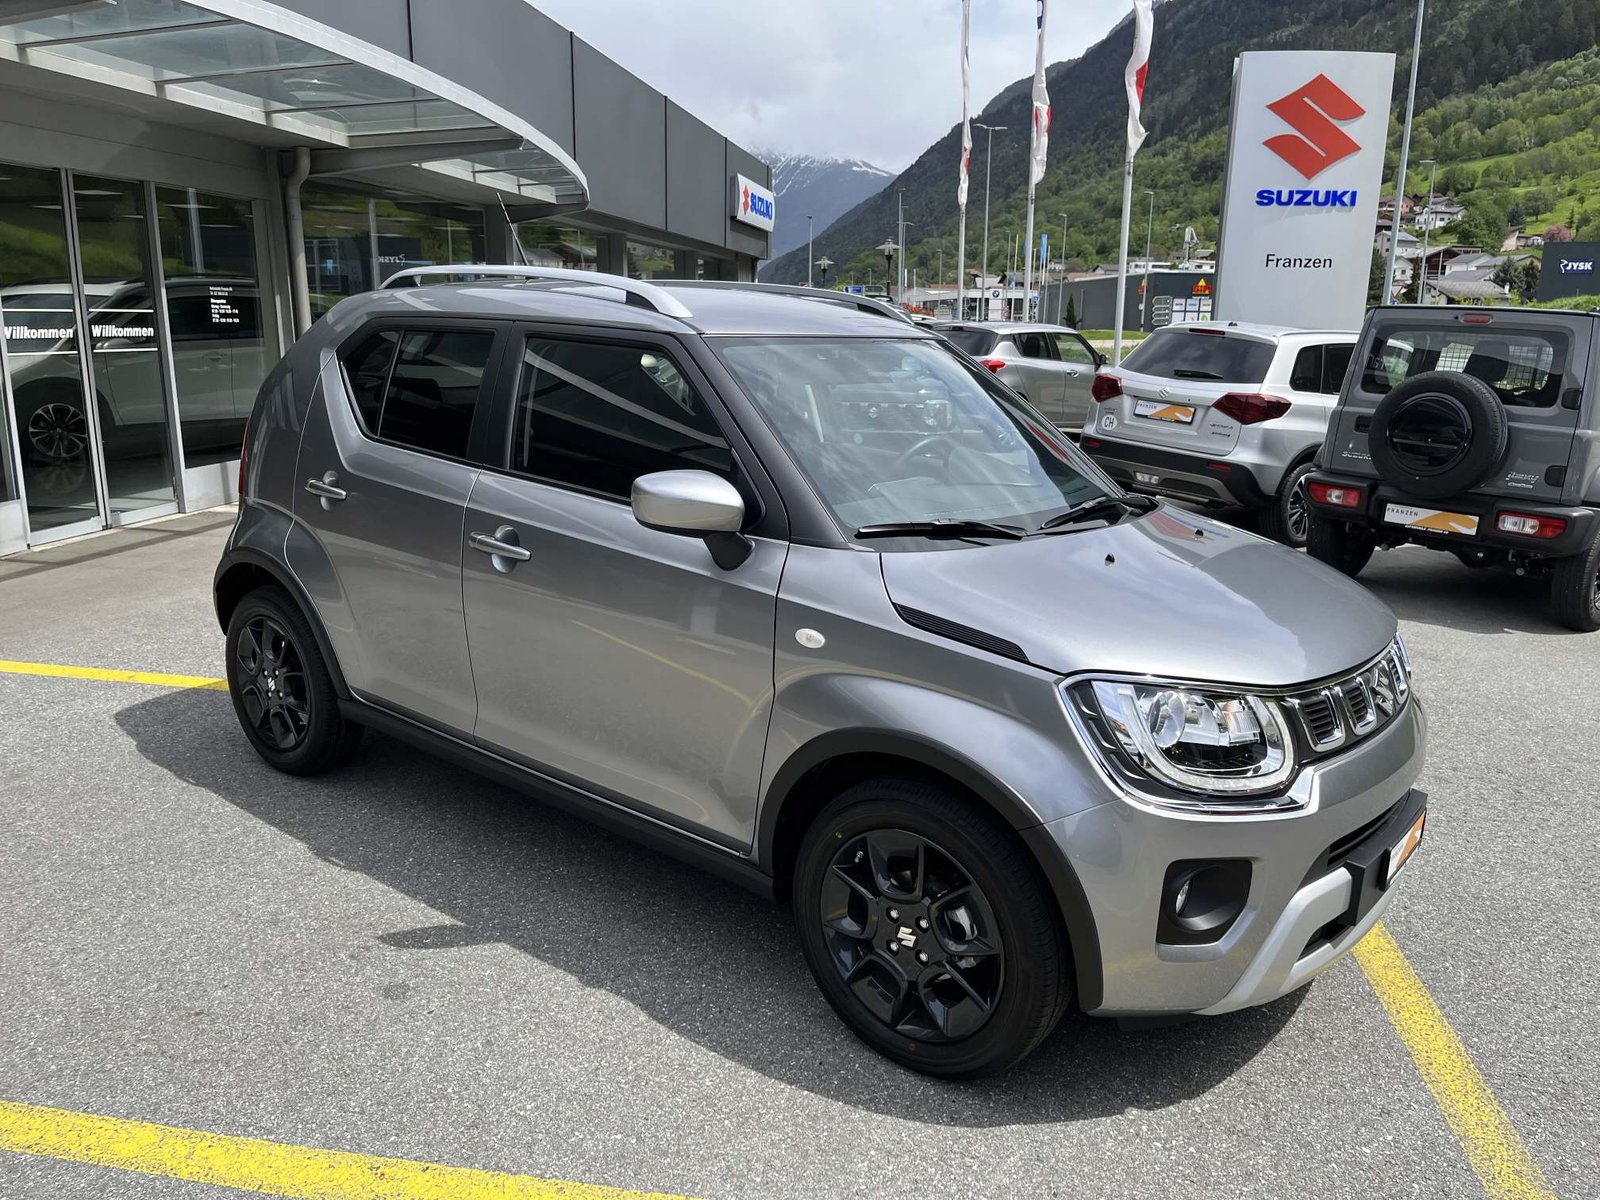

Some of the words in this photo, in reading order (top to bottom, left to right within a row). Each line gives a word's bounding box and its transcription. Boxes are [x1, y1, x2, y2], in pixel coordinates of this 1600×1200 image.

[1255, 189, 1357, 207] SUZUKI
[750, 192, 773, 220] SUZUKI
[1265, 253, 1333, 269] Franzen
[1566, 261, 1593, 270] JYSK
[91, 324, 155, 338] Willkommen
[1104, 416, 1115, 428] CH
[1386, 507, 1419, 517] FRANZEN
